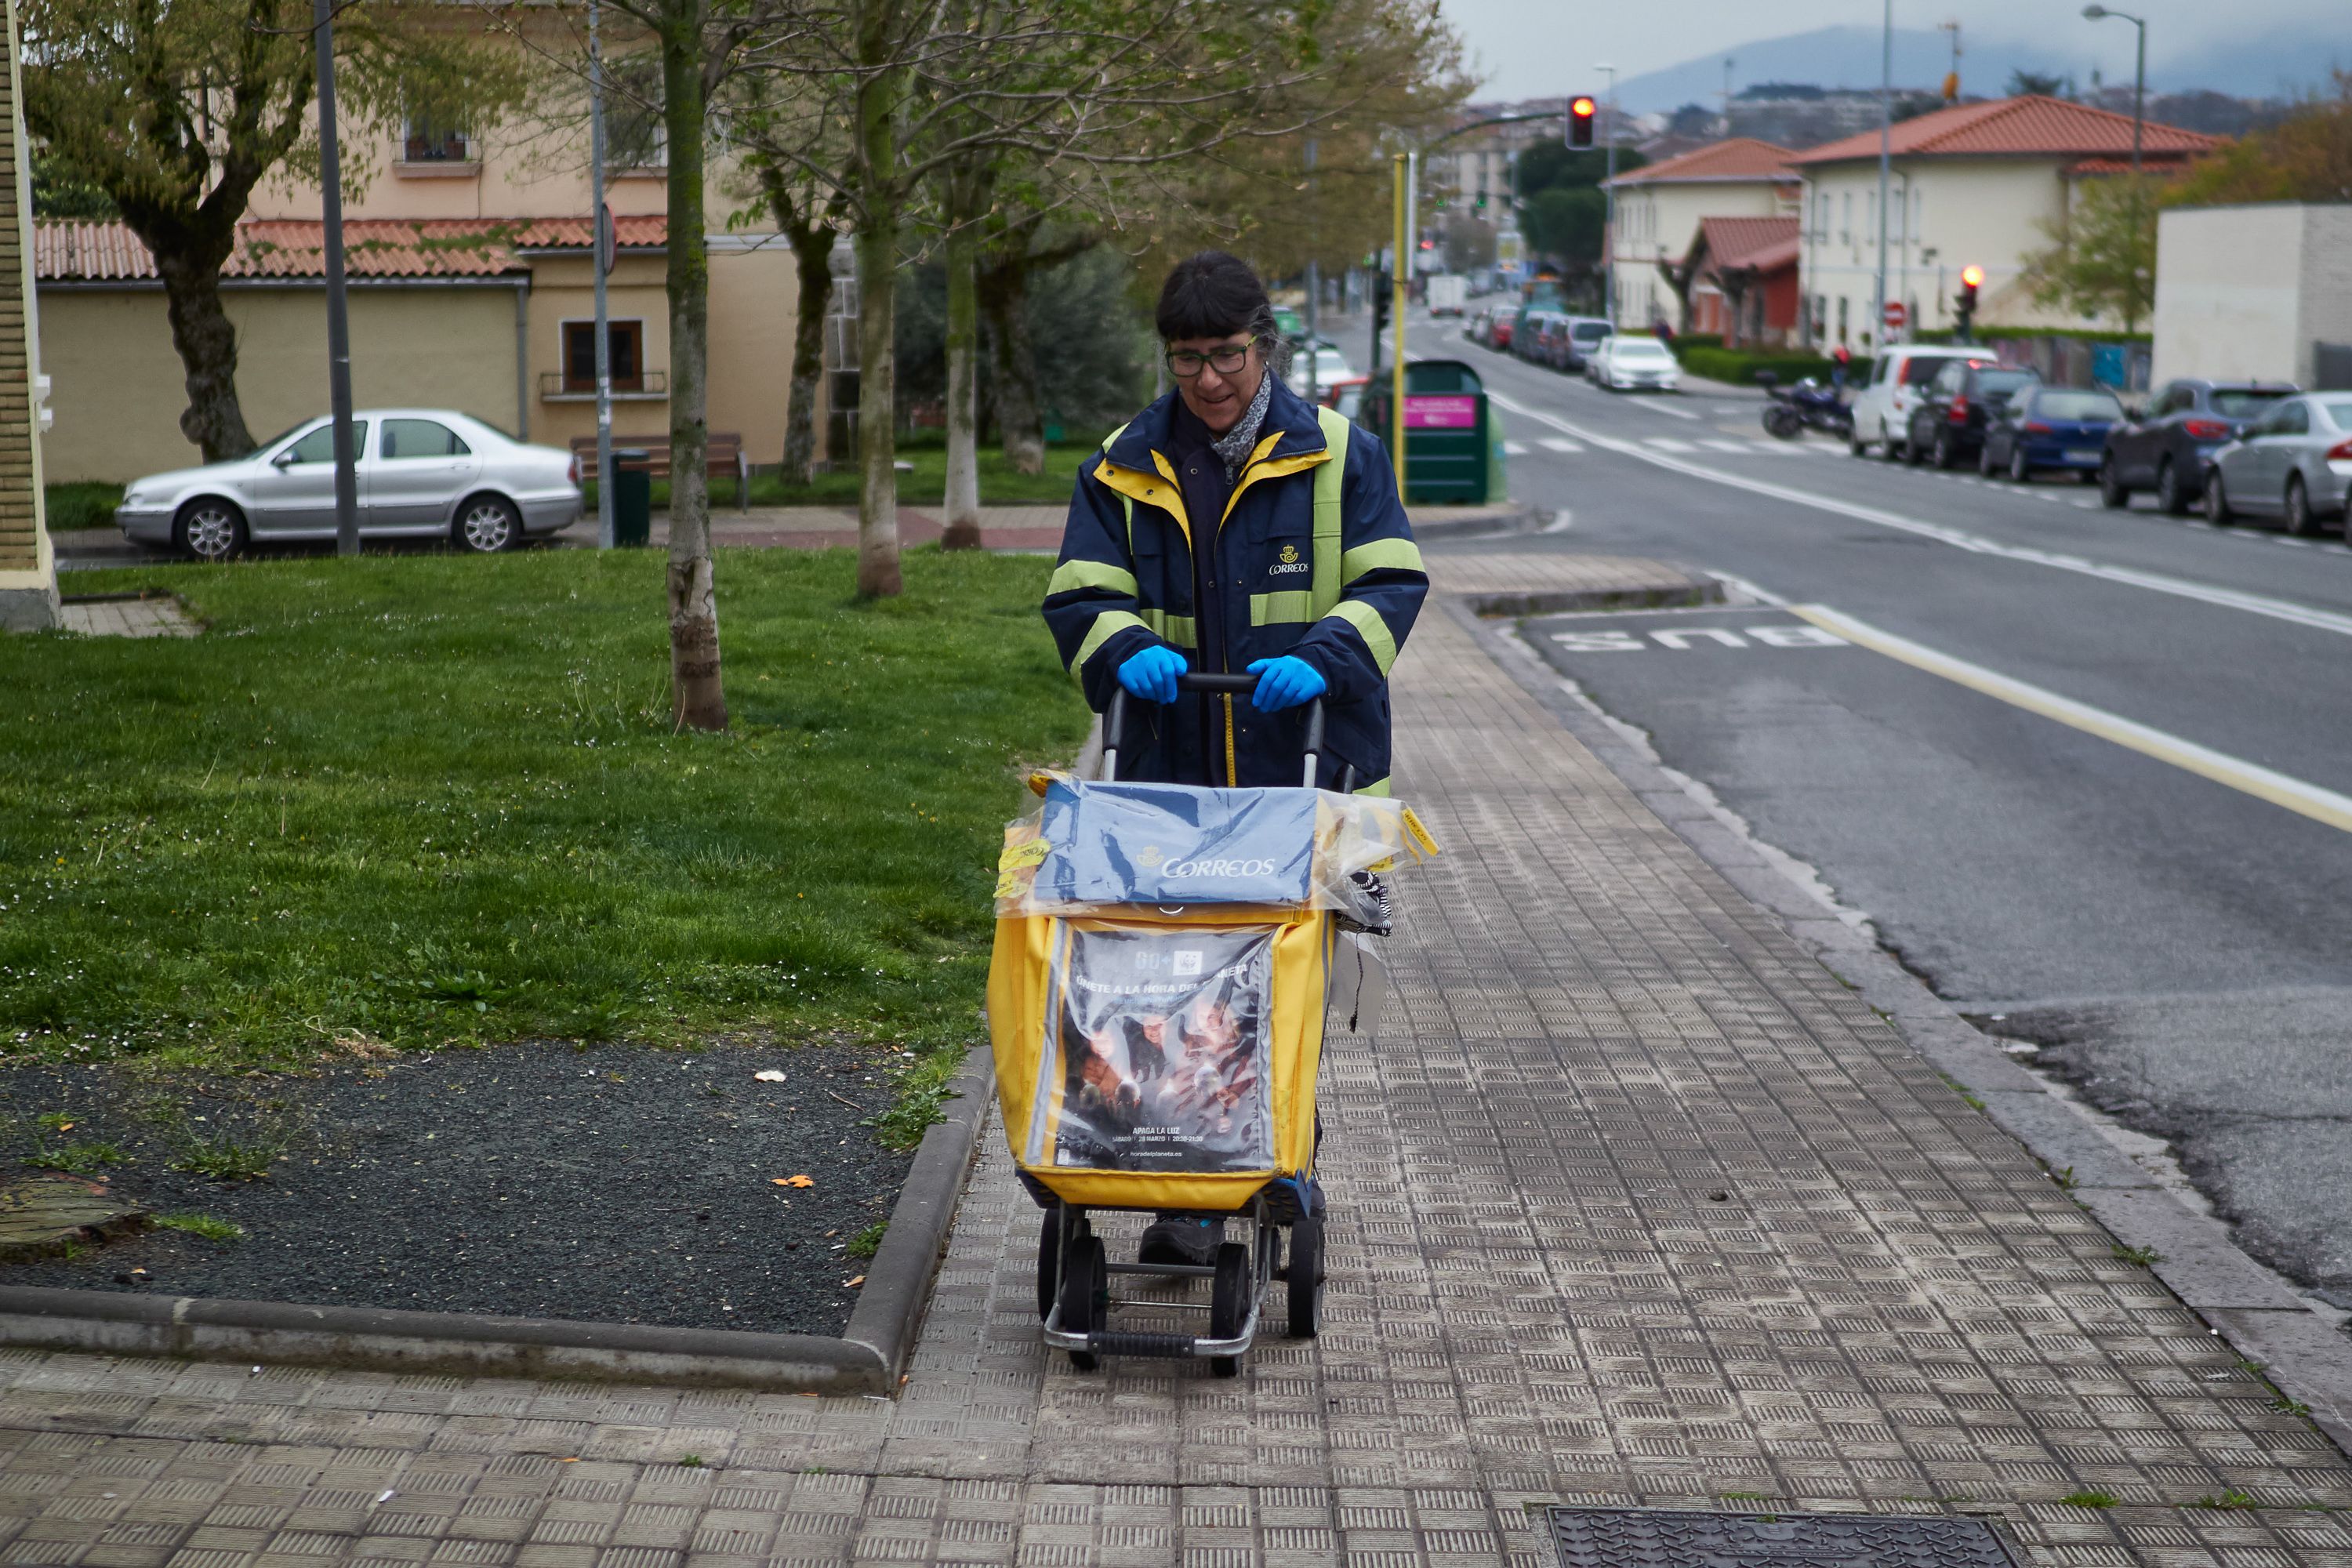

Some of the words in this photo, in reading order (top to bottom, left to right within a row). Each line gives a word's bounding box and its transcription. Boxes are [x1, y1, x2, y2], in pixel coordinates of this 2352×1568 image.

[1269, 564, 1308, 576] CORREOS
[1550, 627, 1851, 652] BUS
[1161, 858, 1276, 878] CORREOS
[1076, 975, 1111, 993] ÚNETE
[1113, 985, 1122, 994] A
[1124, 985, 1140, 995] LA
[1143, 984, 1175, 994] HORA
